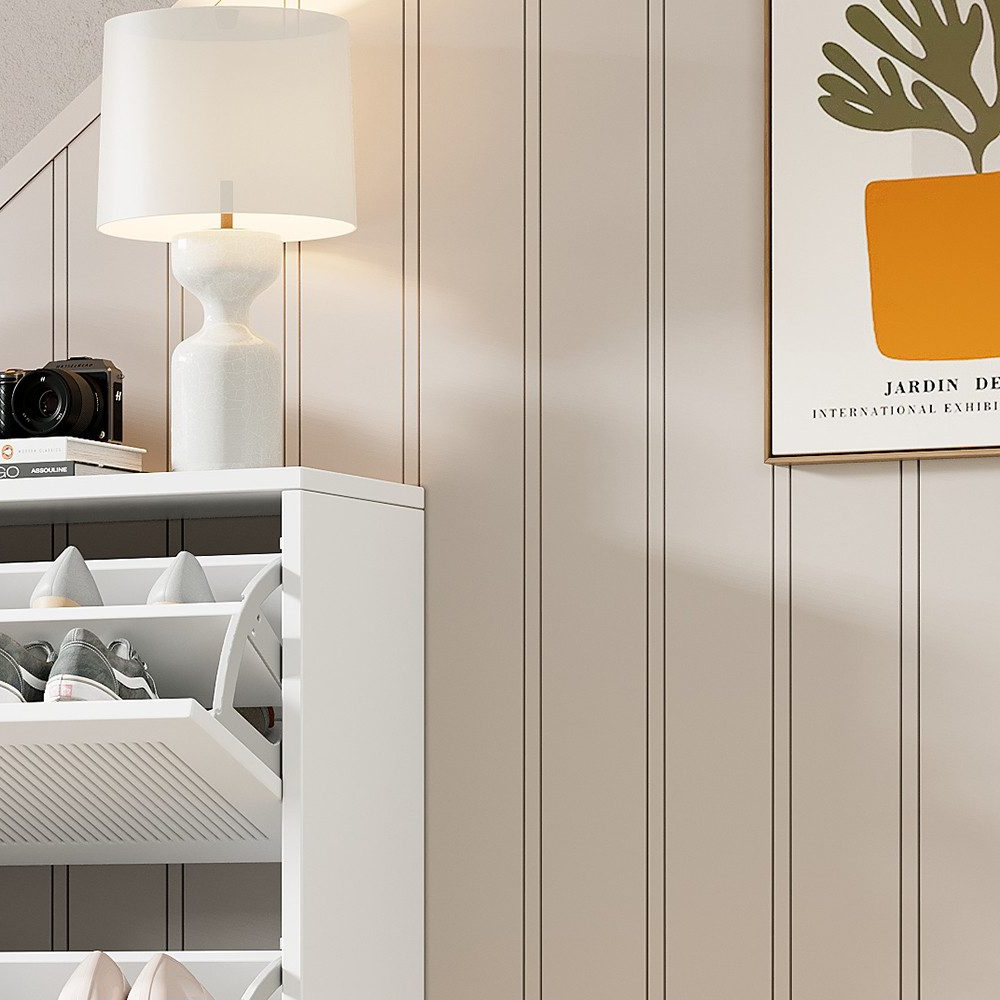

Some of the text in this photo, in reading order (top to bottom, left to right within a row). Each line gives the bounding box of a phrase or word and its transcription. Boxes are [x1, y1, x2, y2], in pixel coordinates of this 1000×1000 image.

[884, 376, 1000, 396] JARDIN DE
[812, 401, 999, 419] INTERNATIONAL EXHIBI
[30, 466, 68, 475] ASSOULINE
